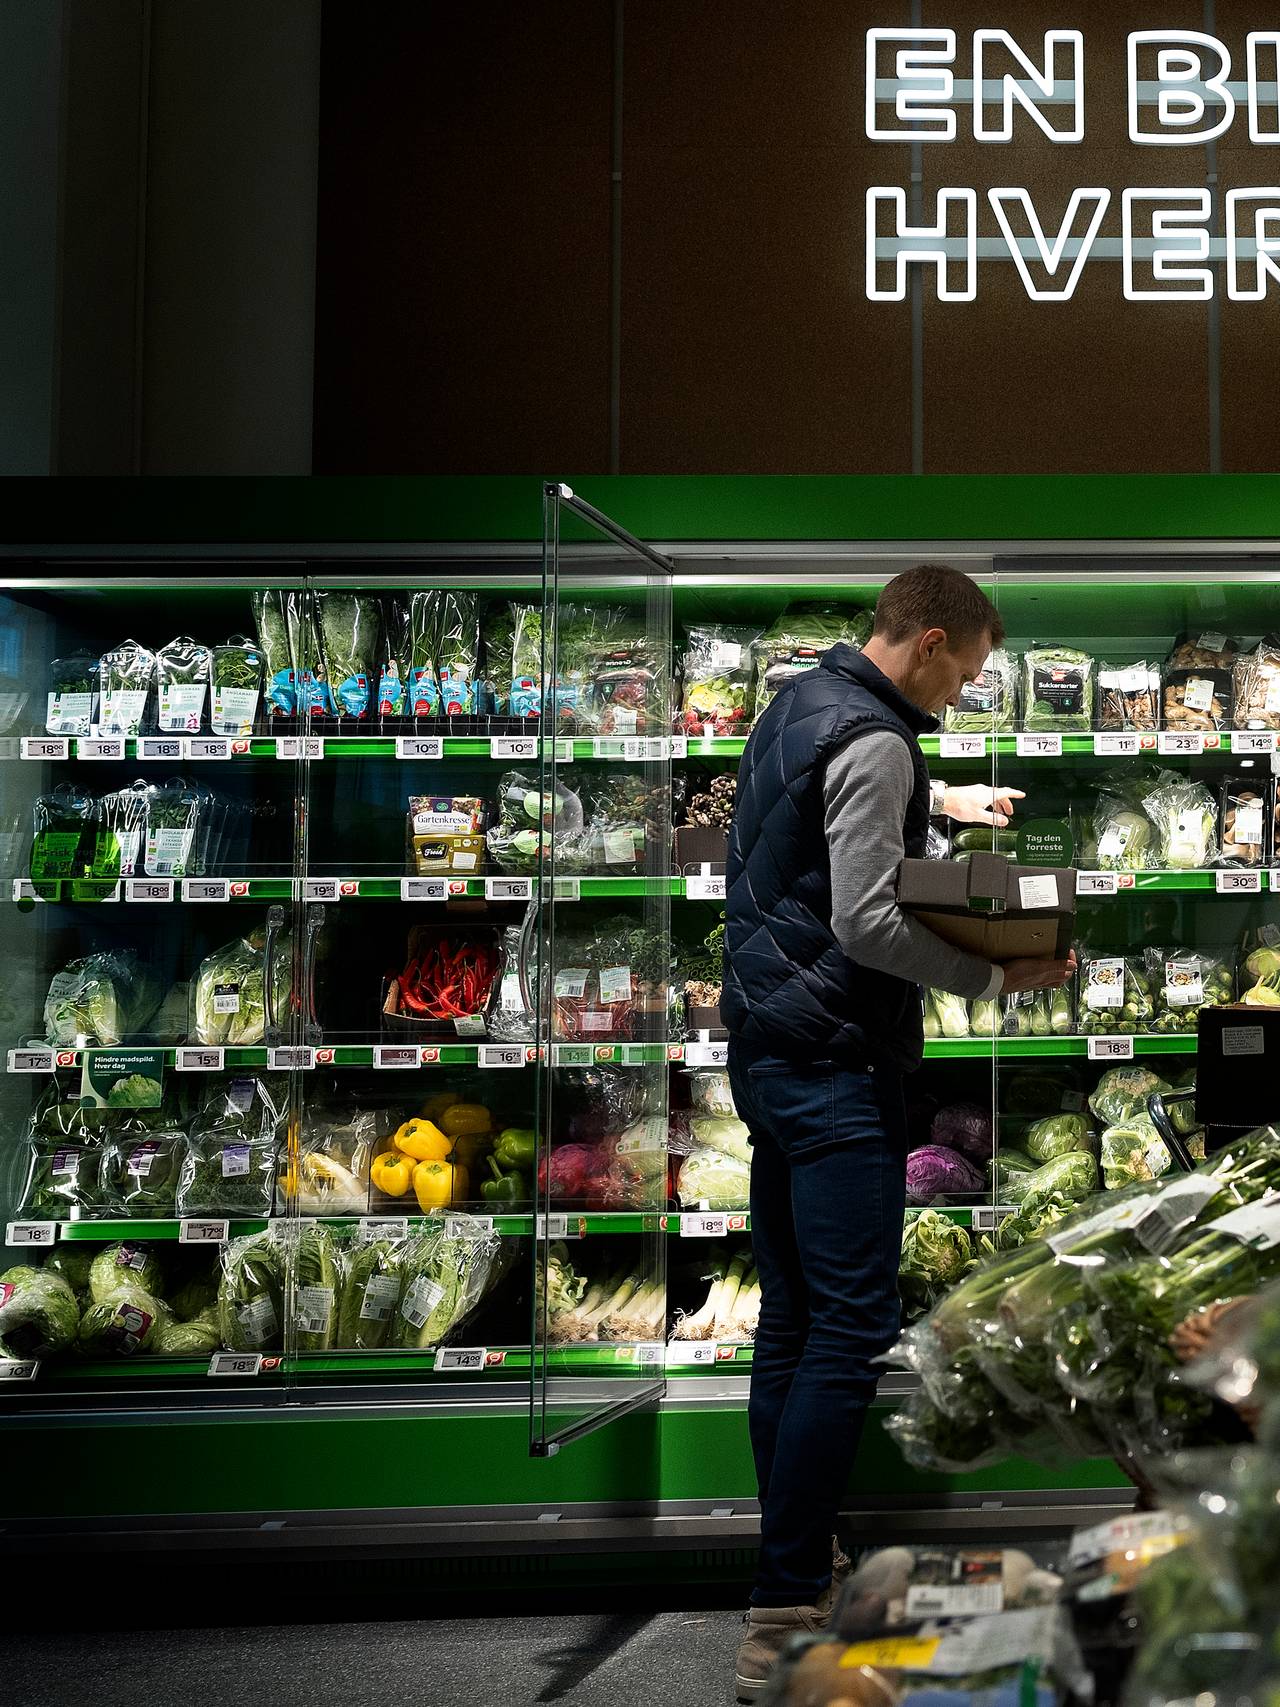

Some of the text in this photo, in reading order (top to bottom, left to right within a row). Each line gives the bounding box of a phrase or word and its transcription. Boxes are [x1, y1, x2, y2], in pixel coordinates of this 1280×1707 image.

[866, 28, 1085, 143] EN
[417, 815, 470, 824] Gartenkresse
[1026, 834, 1061, 843] Tag den
[1026, 843, 1063, 851] forreste
